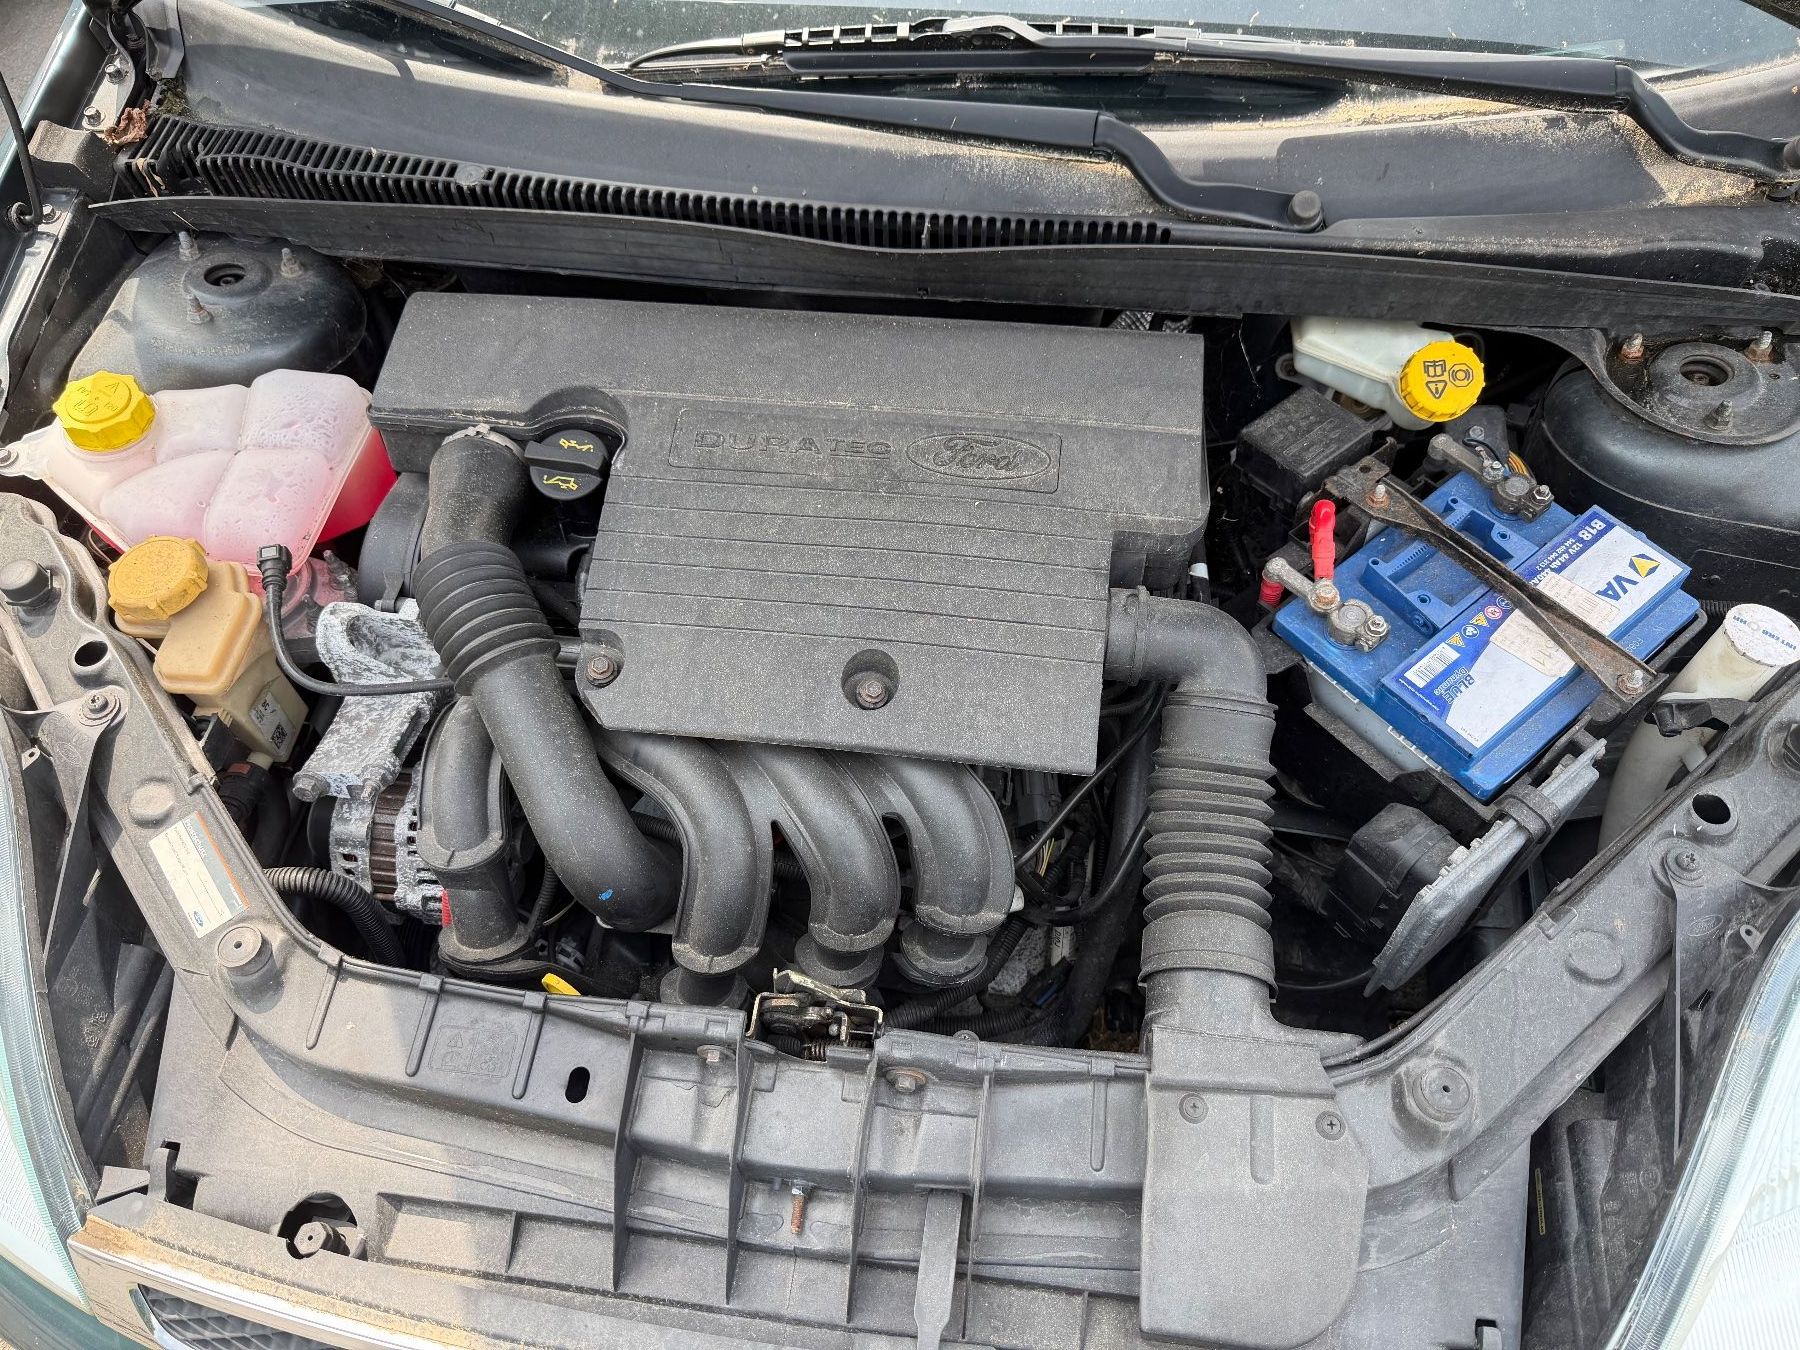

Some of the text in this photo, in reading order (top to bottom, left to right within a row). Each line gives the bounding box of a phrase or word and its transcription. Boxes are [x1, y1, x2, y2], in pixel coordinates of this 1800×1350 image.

[694, 430, 892, 456] DURATEC
[932, 436, 1022, 472] Ford
[1578, 518, 1607, 541] B18
[1568, 541, 1583, 555] 12V
[1441, 673, 1476, 704] BLUE
